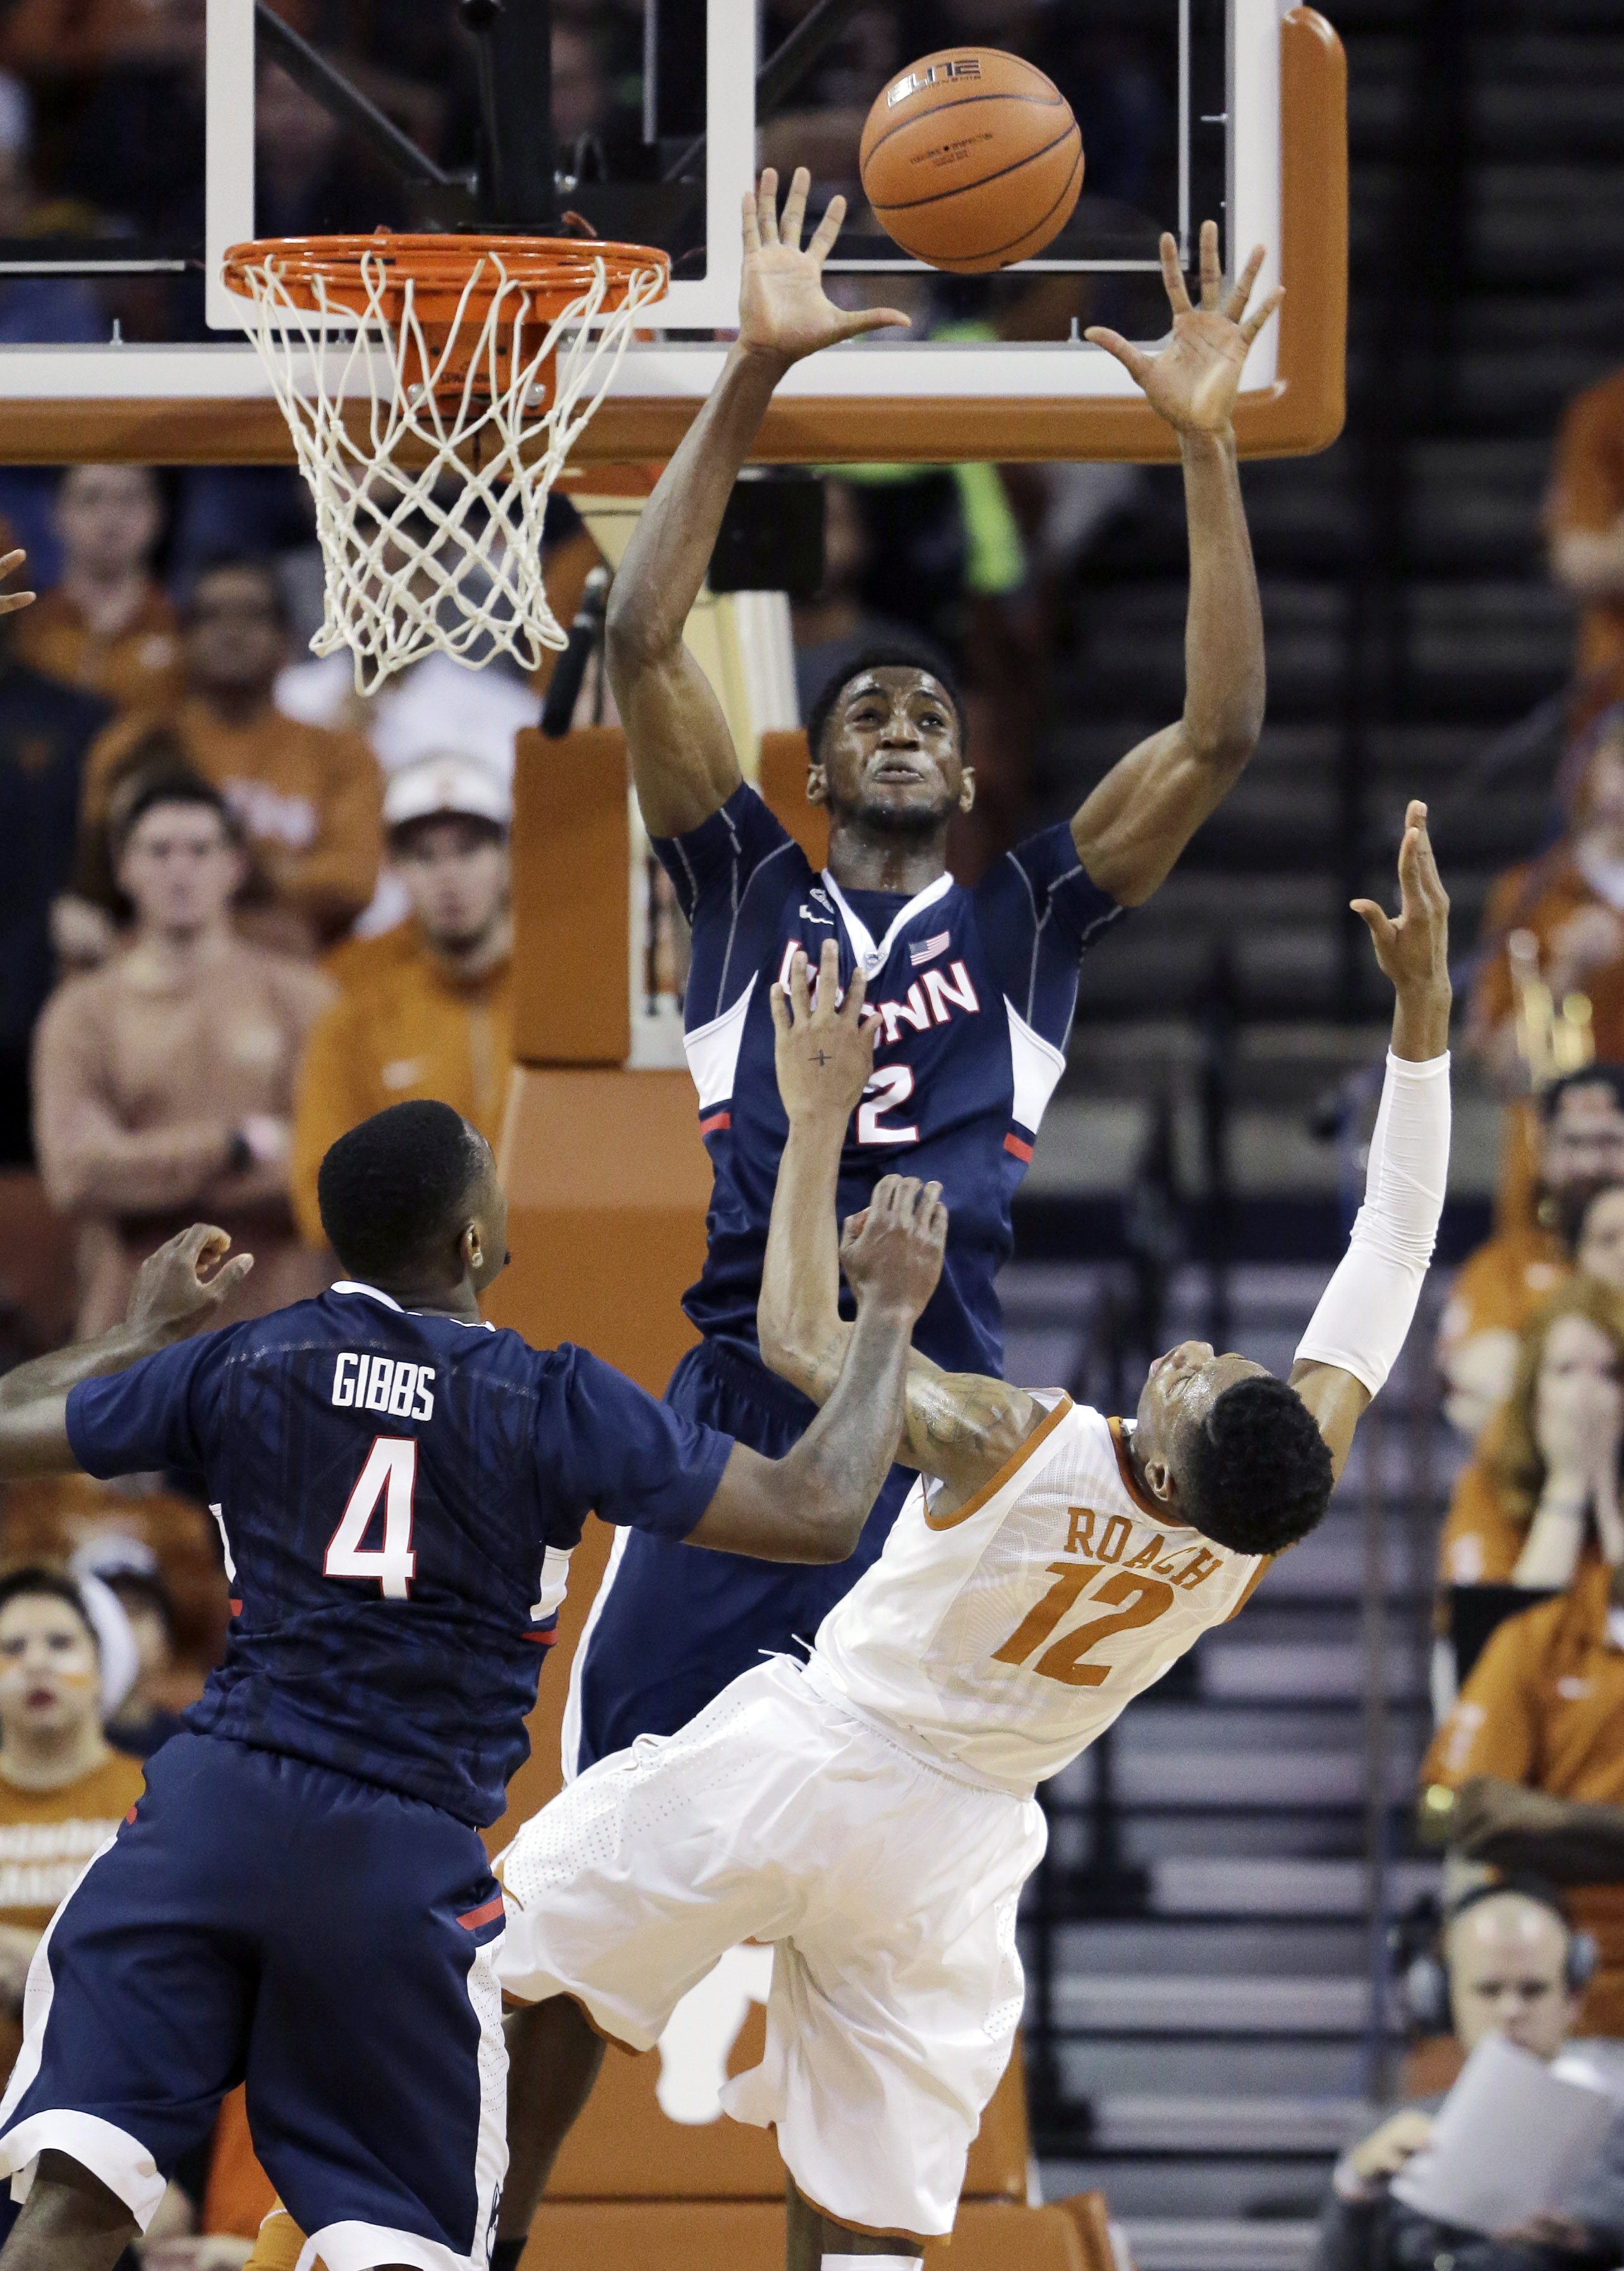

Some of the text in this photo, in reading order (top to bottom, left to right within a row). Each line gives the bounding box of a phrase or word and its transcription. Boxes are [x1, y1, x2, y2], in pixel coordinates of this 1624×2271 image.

[332, 1351, 435, 1422] GIBBS
[323, 1435, 418, 1600] 4
[1063, 1507, 1223, 1590] ROACH
[990, 1561, 1174, 1686] 12
